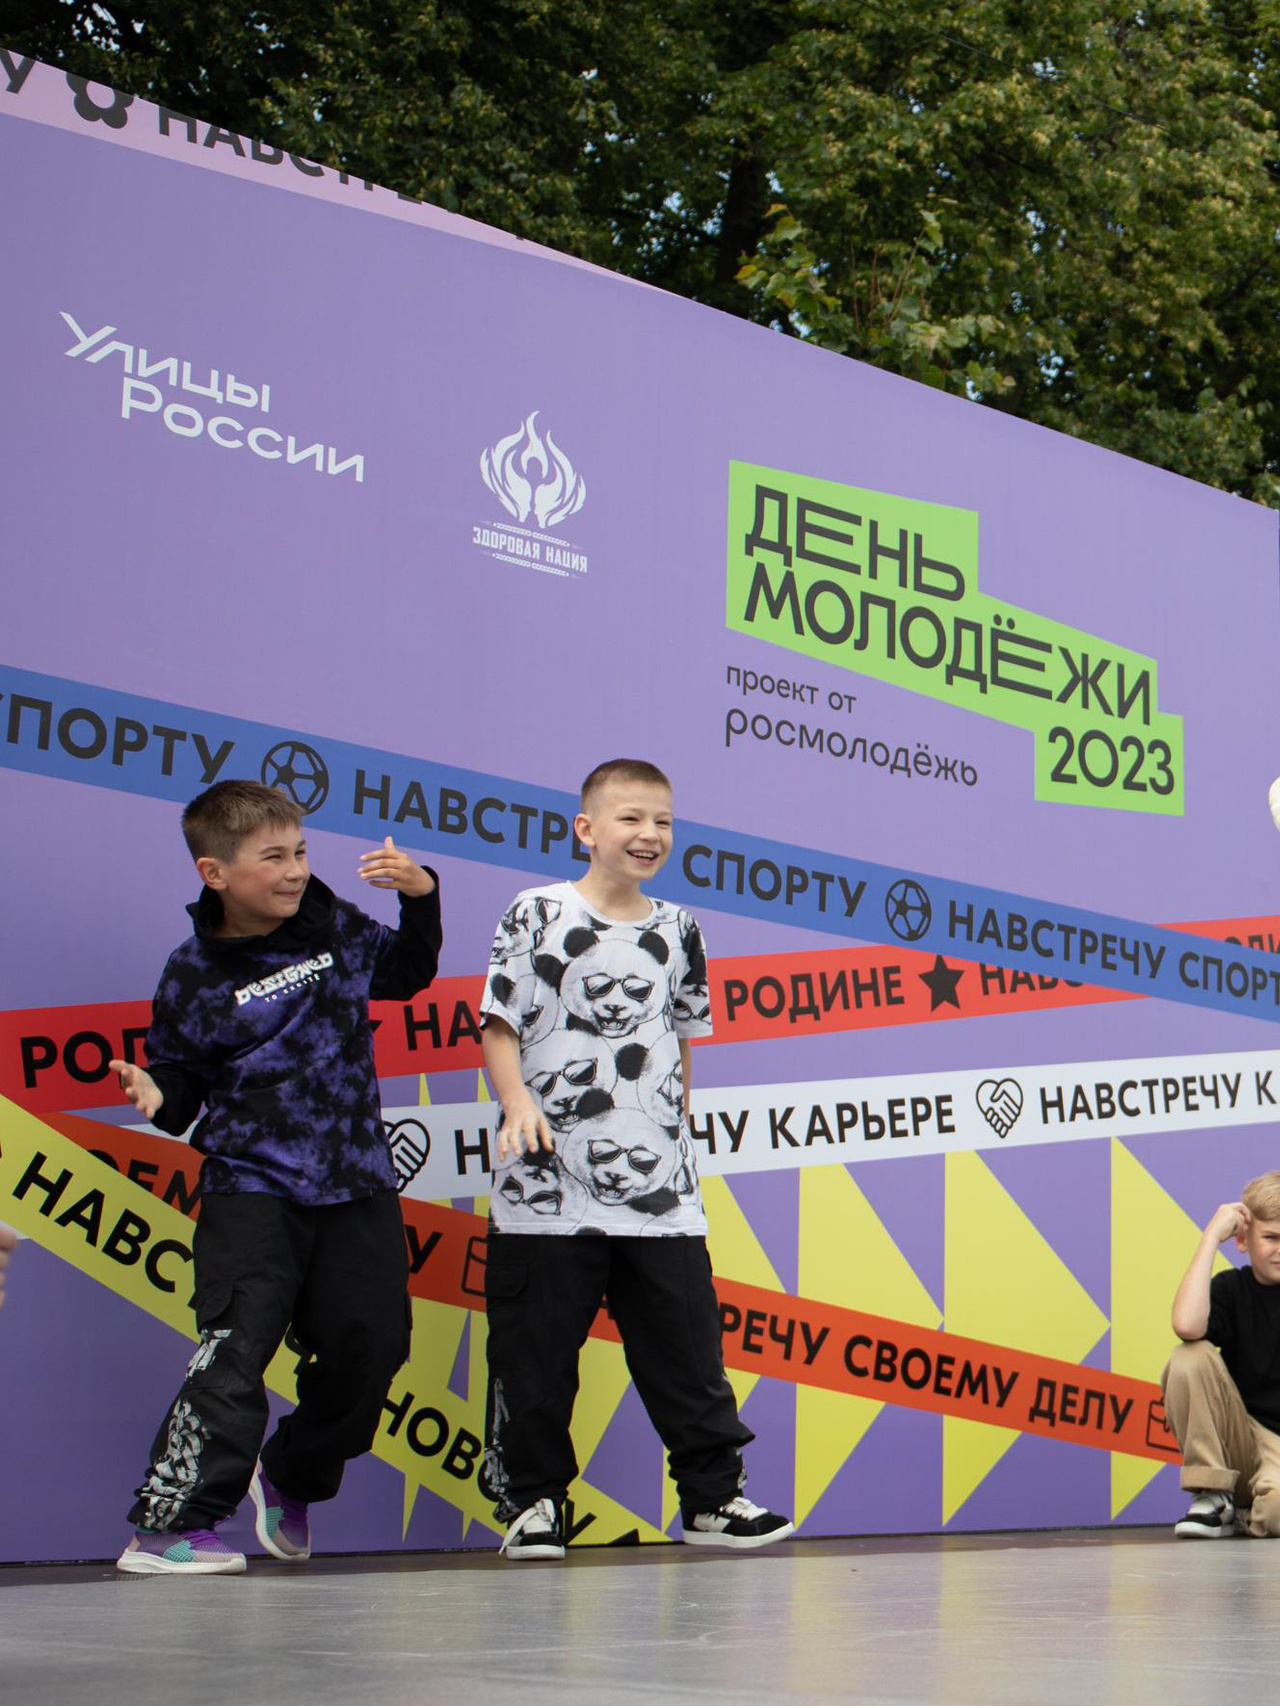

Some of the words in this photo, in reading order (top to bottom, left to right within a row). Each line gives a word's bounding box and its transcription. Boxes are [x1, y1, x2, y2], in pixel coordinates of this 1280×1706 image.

[472, 526, 540, 560] ЗДОРОВАЯ
[545, 546, 588, 573] НАЦИЯ
[745, 484, 965, 601] ДЕНЬ
[744, 561, 1150, 726] МОЛОДЁЖИ
[727, 666, 819, 704] проект
[828, 691, 857, 713] от
[726, 708, 978, 786] росмолодёжь
[1048, 726, 1175, 796] 2023
[0, 693, 235, 784] ПОРТУ
[682, 844, 867, 918] СПОРТУ
[949, 900, 1166, 979] НАВСТРЕЧУ
[724, 965, 905, 1024] РОДИНЕ
[768, 1094, 956, 1149] КАРЬЕРЕ
[1040, 1073, 1241, 1124] НАВСТРЕЧУ
[844, 1334, 1019, 1408] СВОЕМУ
[1028, 1377, 1134, 1433] ДЕЛУ
